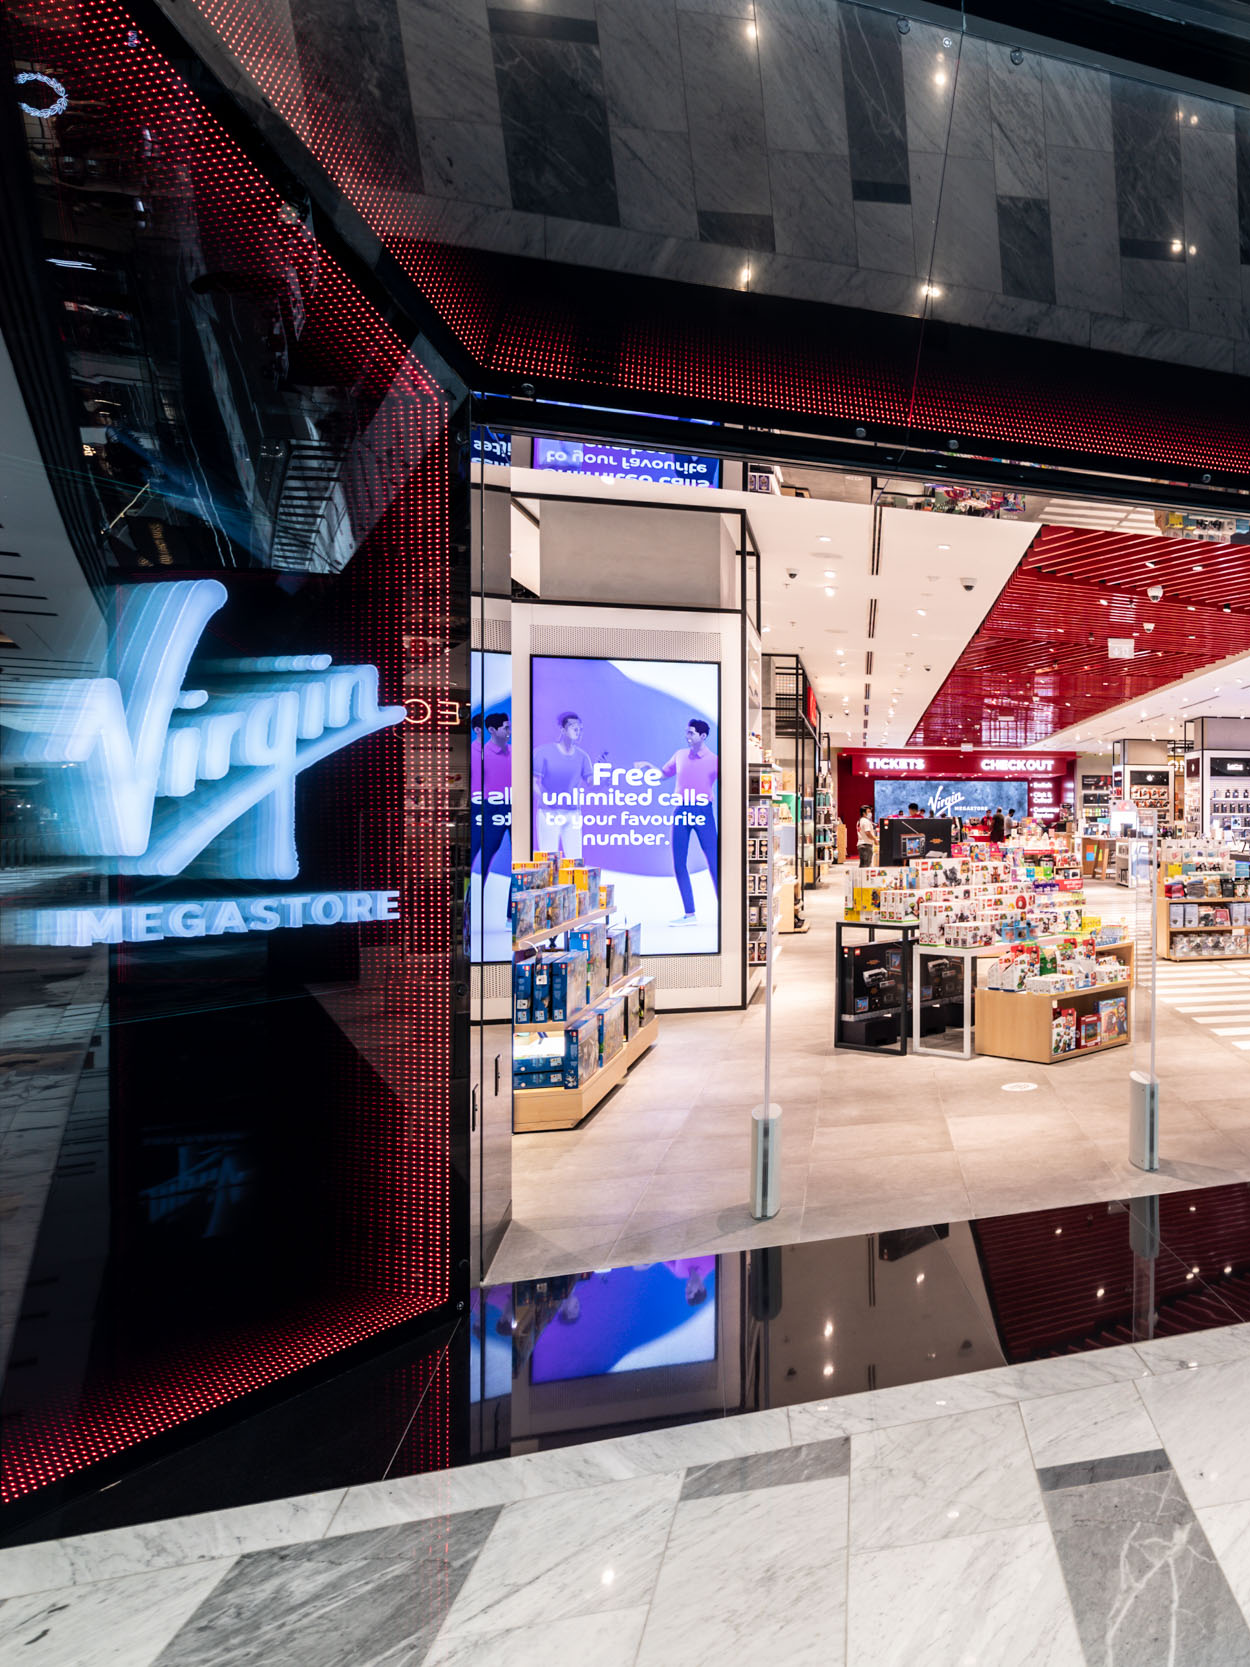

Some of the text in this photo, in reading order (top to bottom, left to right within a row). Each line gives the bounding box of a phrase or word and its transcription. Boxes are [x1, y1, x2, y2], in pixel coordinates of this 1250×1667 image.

[22, 579, 407, 881] Virgin
[866, 757, 926, 770] TICKETS
[980, 759, 1055, 771] CHECKOUT
[593, 762, 662, 786] Free
[542, 787, 709, 807] unlimited calls
[927, 785, 965, 818] Virgin
[545, 811, 706, 829] to your favourite
[583, 829, 670, 846] number.
[50, 890, 401, 947] MEGASTORE
